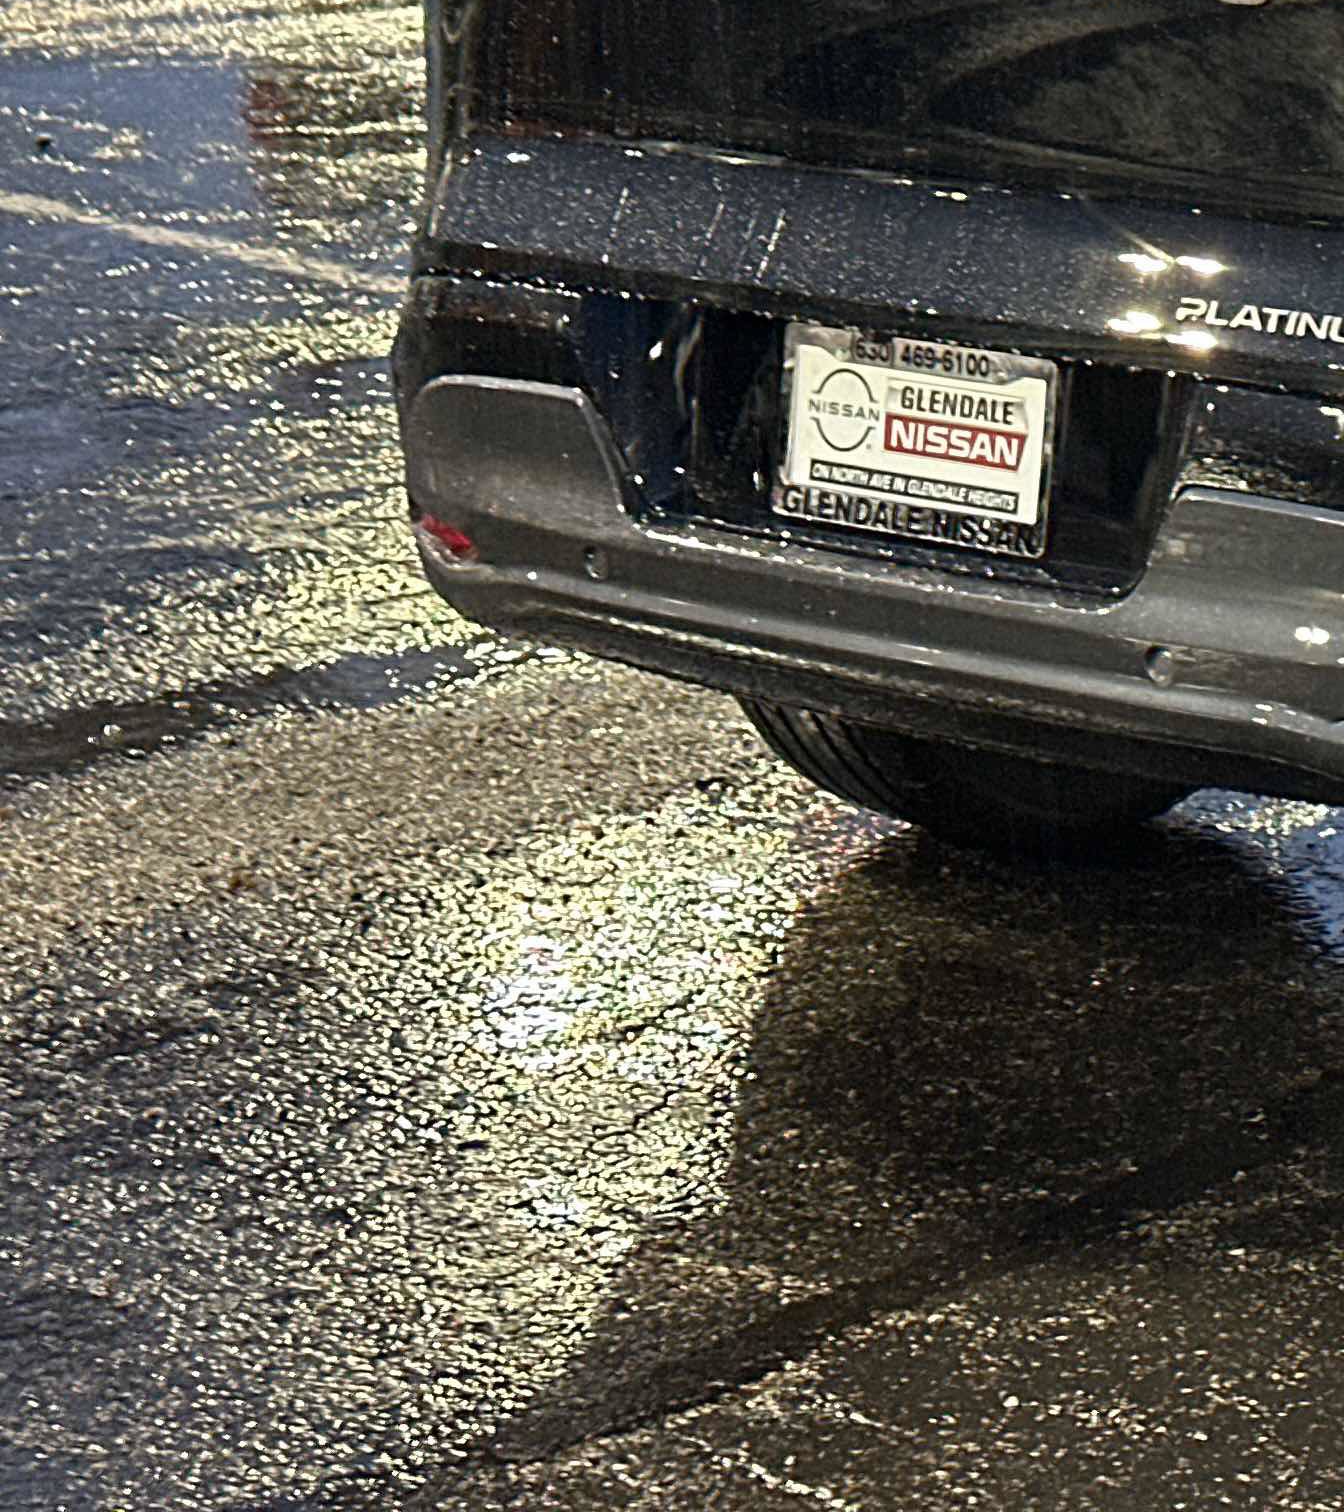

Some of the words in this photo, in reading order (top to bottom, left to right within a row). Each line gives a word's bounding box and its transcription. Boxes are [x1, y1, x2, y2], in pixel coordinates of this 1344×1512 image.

[808, 398, 881, 422] NISSAN
[900, 385, 1015, 426] GLENDALE
[890, 418, 1019, 467] NISSAN
[782, 486, 930, 535] GLENDALE
[907, 478, 967, 503] GLENDALE
